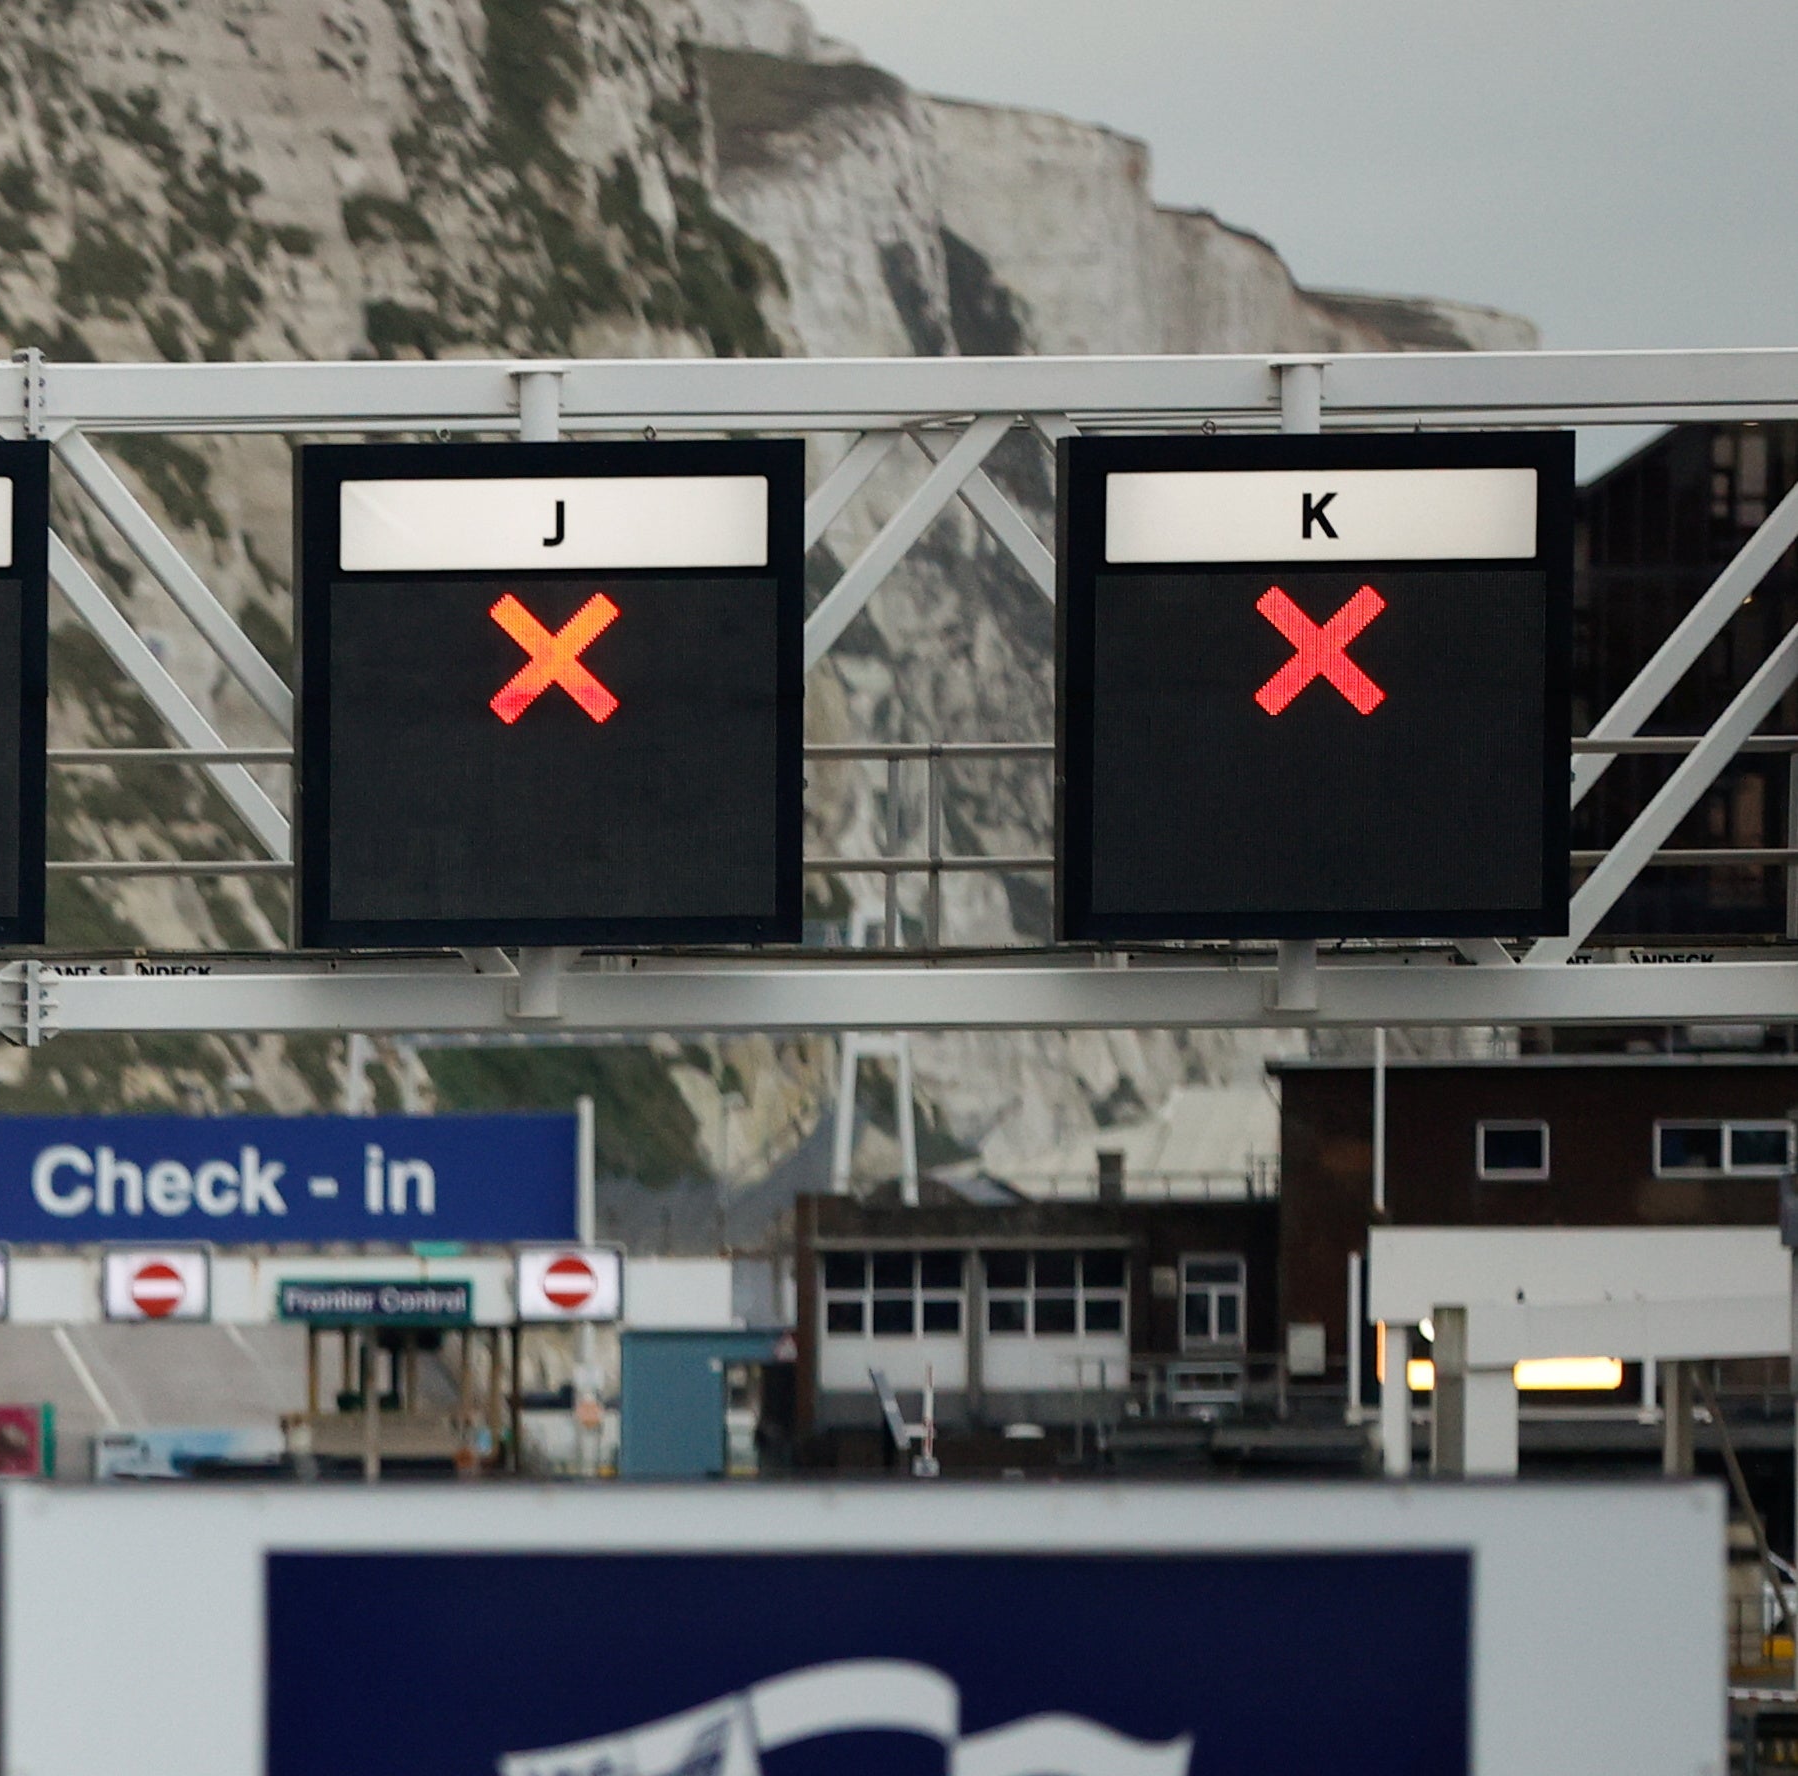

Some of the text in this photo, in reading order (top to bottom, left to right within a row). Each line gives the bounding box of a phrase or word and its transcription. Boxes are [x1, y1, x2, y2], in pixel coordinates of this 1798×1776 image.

[541, 499, 566, 548] J
[1301, 491, 1340, 541] K
[30, 1142, 289, 1218] Check
[363, 1142, 437, 1217] in
[377, 1285, 467, 1314] Control
